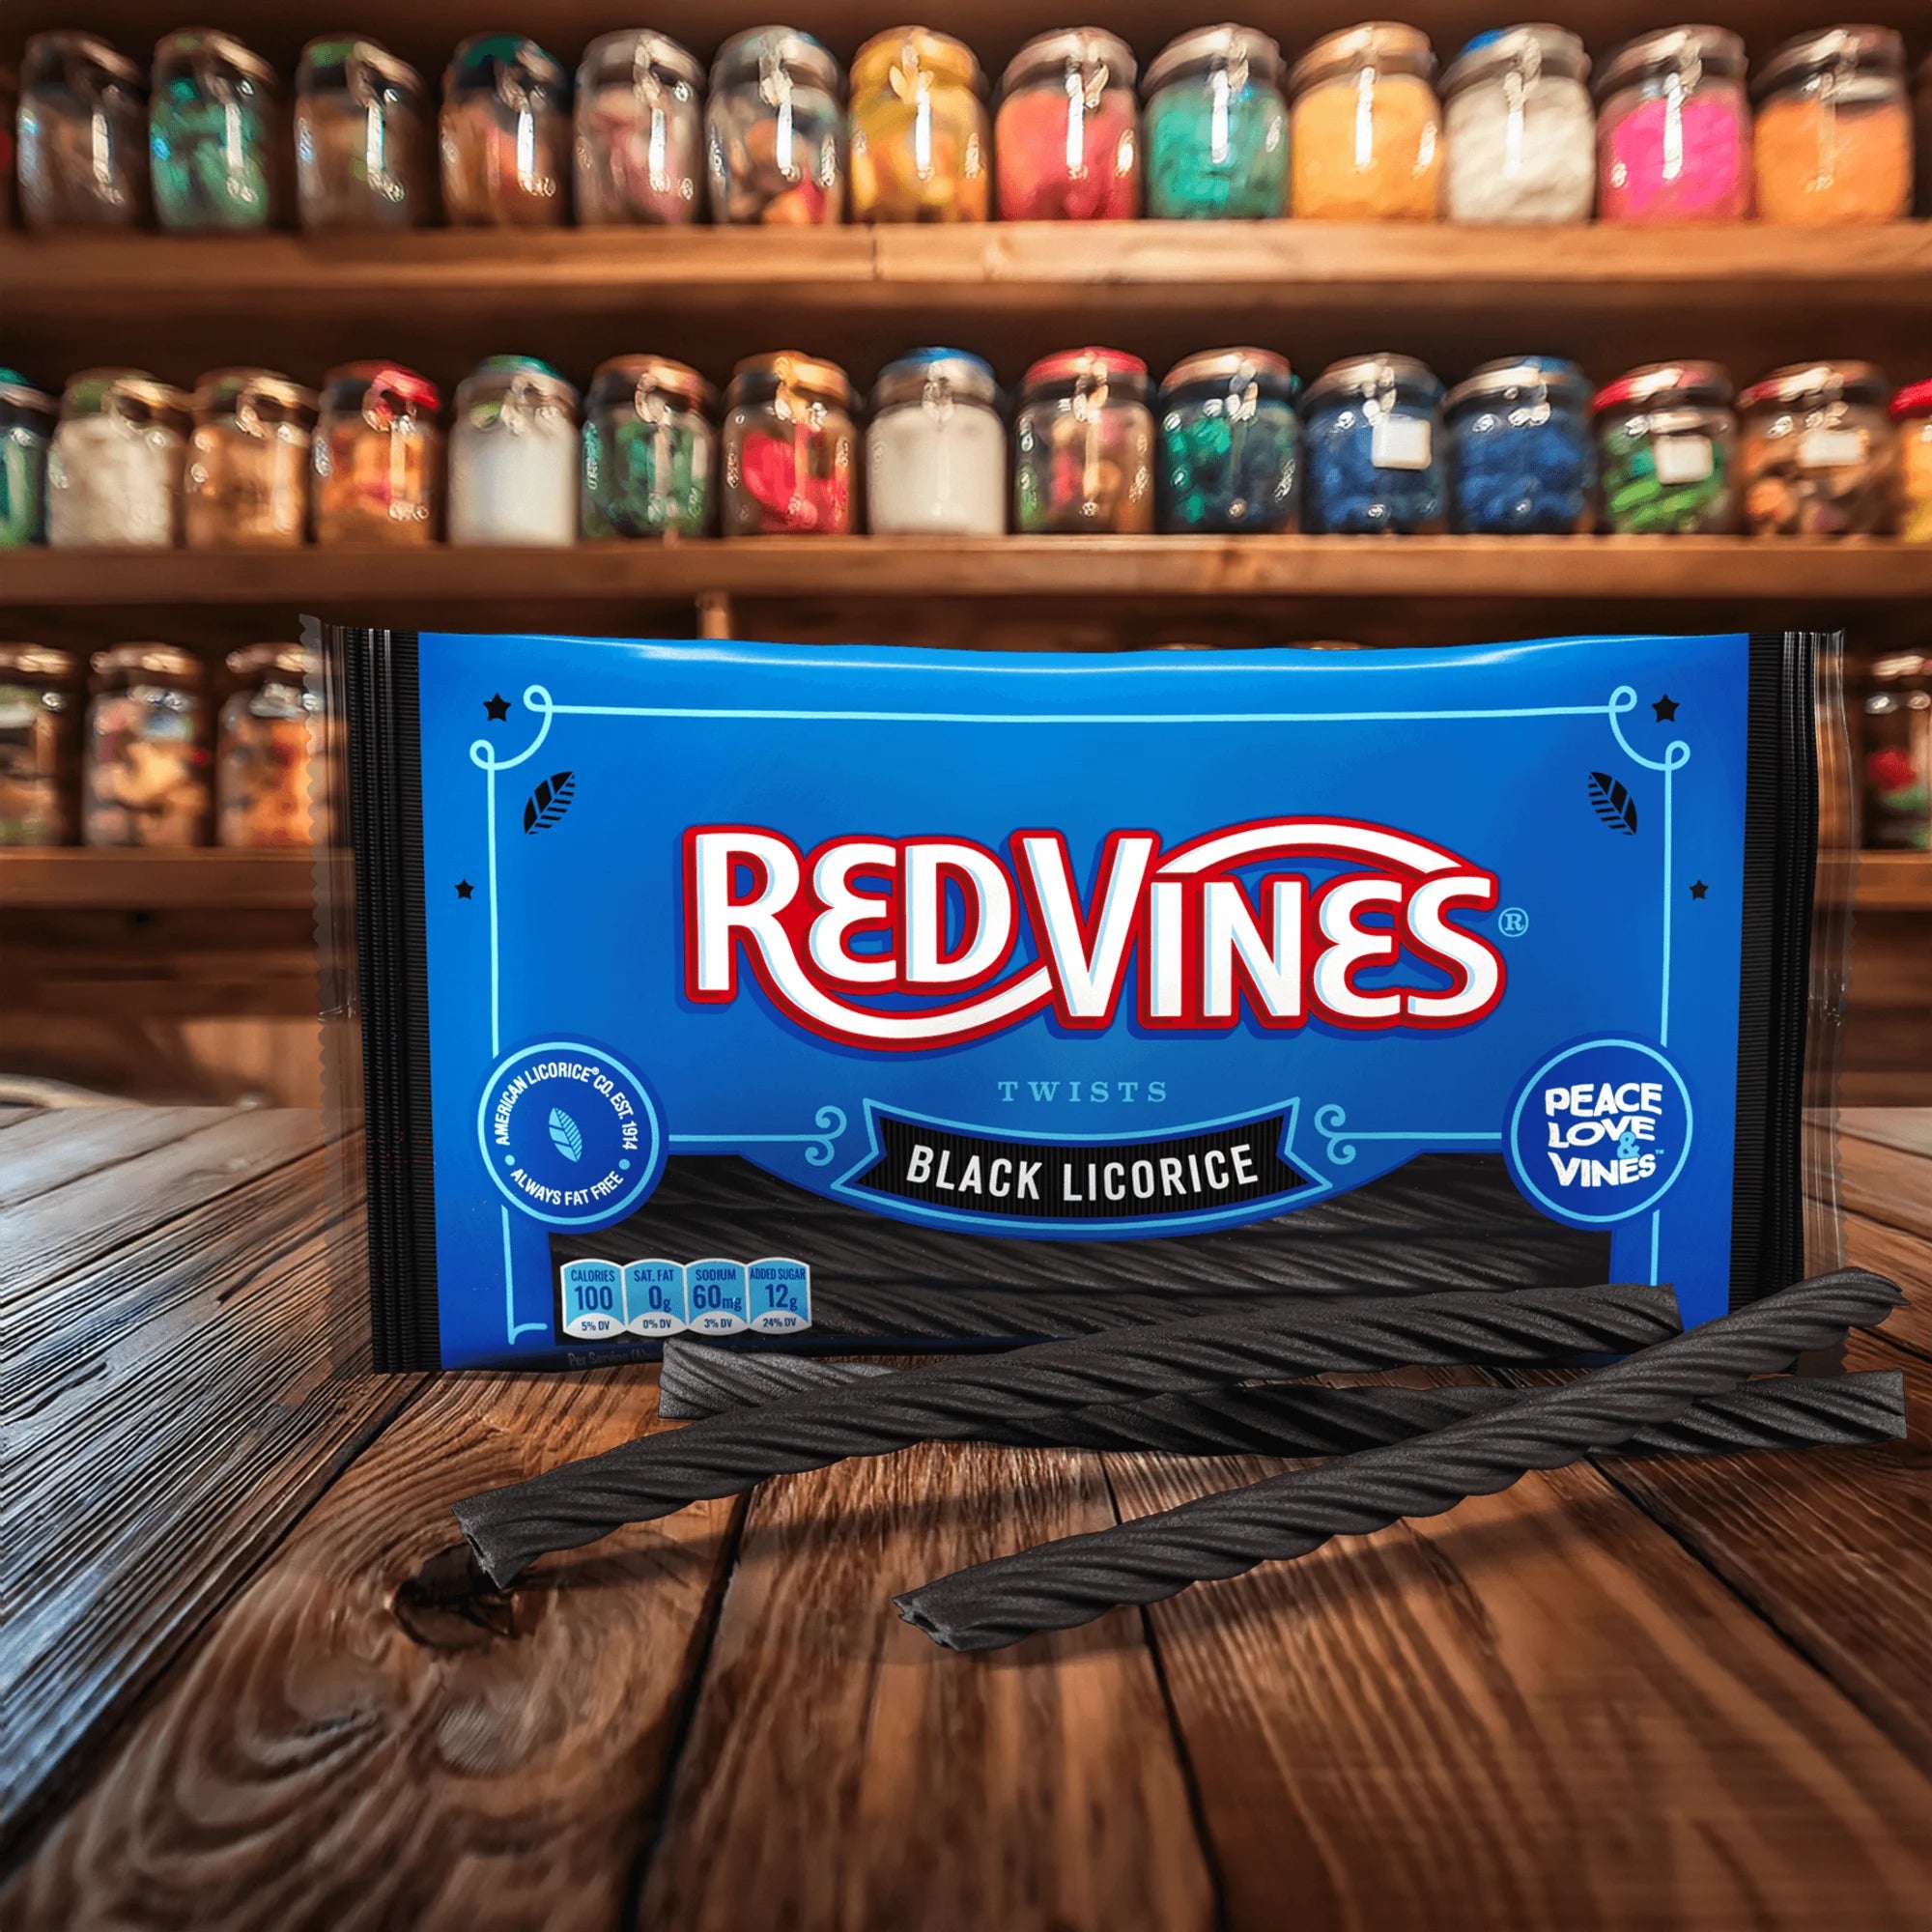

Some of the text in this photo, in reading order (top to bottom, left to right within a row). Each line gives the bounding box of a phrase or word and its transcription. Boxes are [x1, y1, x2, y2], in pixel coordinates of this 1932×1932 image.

[593, 1074, 615, 1098] CO.
[997, 1081, 1167, 1103] TWISTS
[495, 1075, 528, 1146] AMERICAN
[610, 1093, 635, 1120] EST.
[1545, 1082, 1663, 1118] PEACE
[621, 1121, 639, 1151] 1914
[1548, 1116, 1656, 1159] LOVE &
[906, 1143, 1259, 1202] BLACK LICORICE
[510, 1168, 624, 1207] ALWAYS FAT FREE
[571, 1268, 615, 1282] CALORIES
[634, 1268, 674, 1282] SAT. FAT
[696, 1268, 736, 1281] SODIUM
[750, 1267, 807, 1281] ADDED SUGAR
[574, 1285, 613, 1311] 100
[648, 1285, 672, 1313] 0g
[693, 1284, 742, 1312] 60mg
[764, 1284, 798, 1311] 12g
[581, 1321, 611, 1332] 5% DV
[642, 1319, 672, 1329] 0% DV
[703, 1318, 732, 1329] 3% DV
[762, 1317, 797, 1329] 24% DV
[567, 1351, 586, 1367] Per
